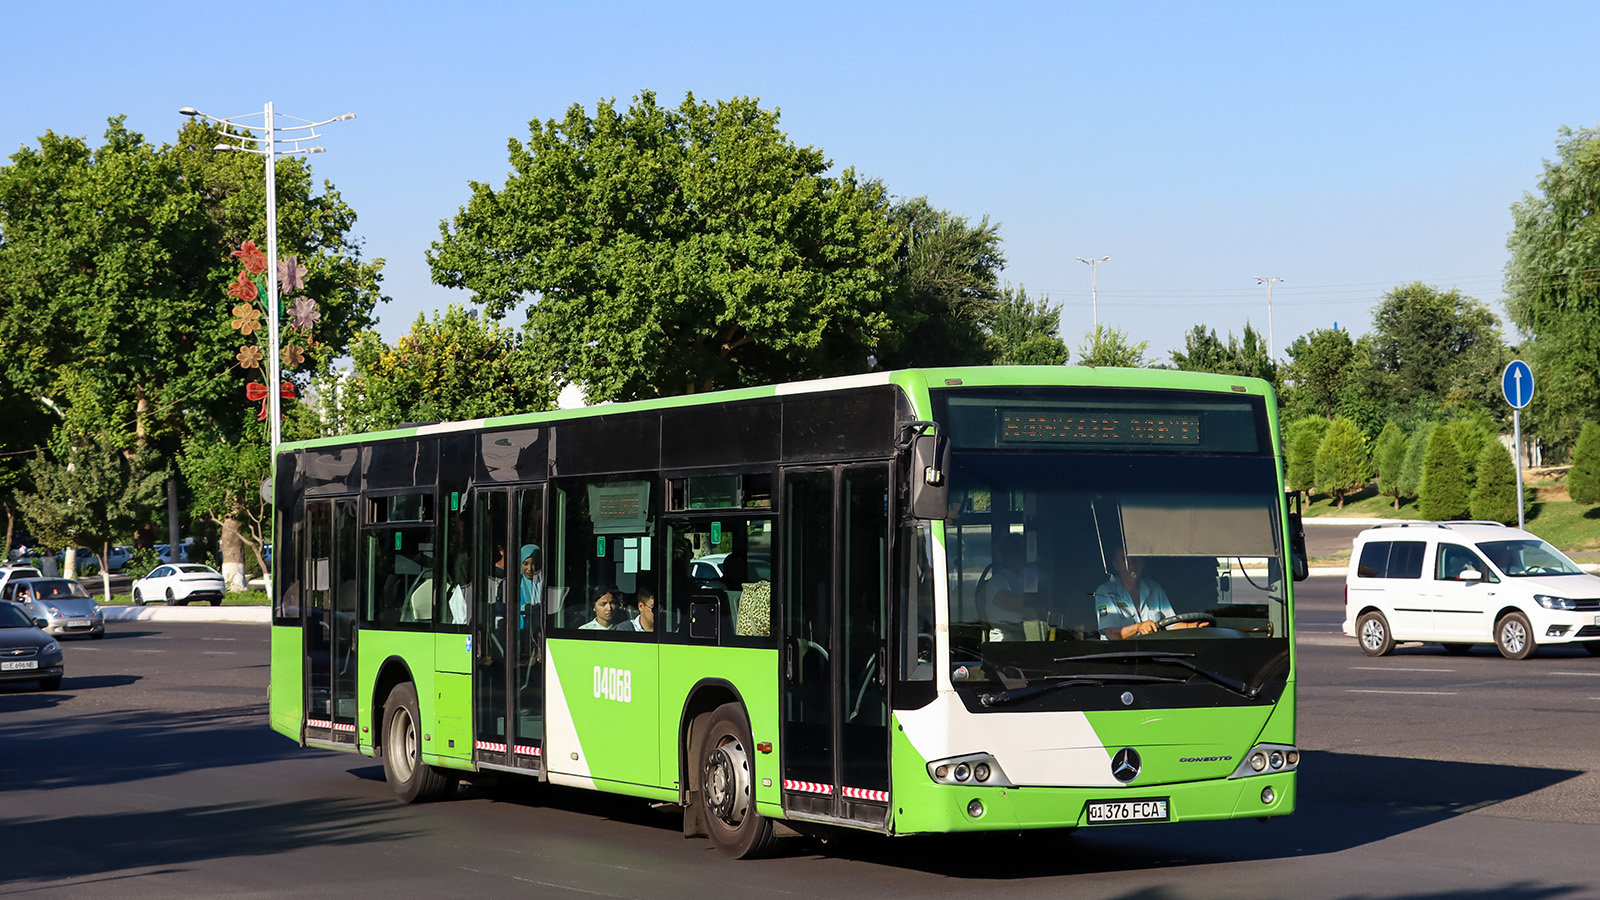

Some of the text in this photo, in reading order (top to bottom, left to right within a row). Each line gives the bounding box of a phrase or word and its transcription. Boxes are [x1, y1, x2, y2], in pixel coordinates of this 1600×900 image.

[594, 666, 631, 702] 04068
[1105, 804, 1129, 819] 376
[1133, 802, 1160, 818] FCA
